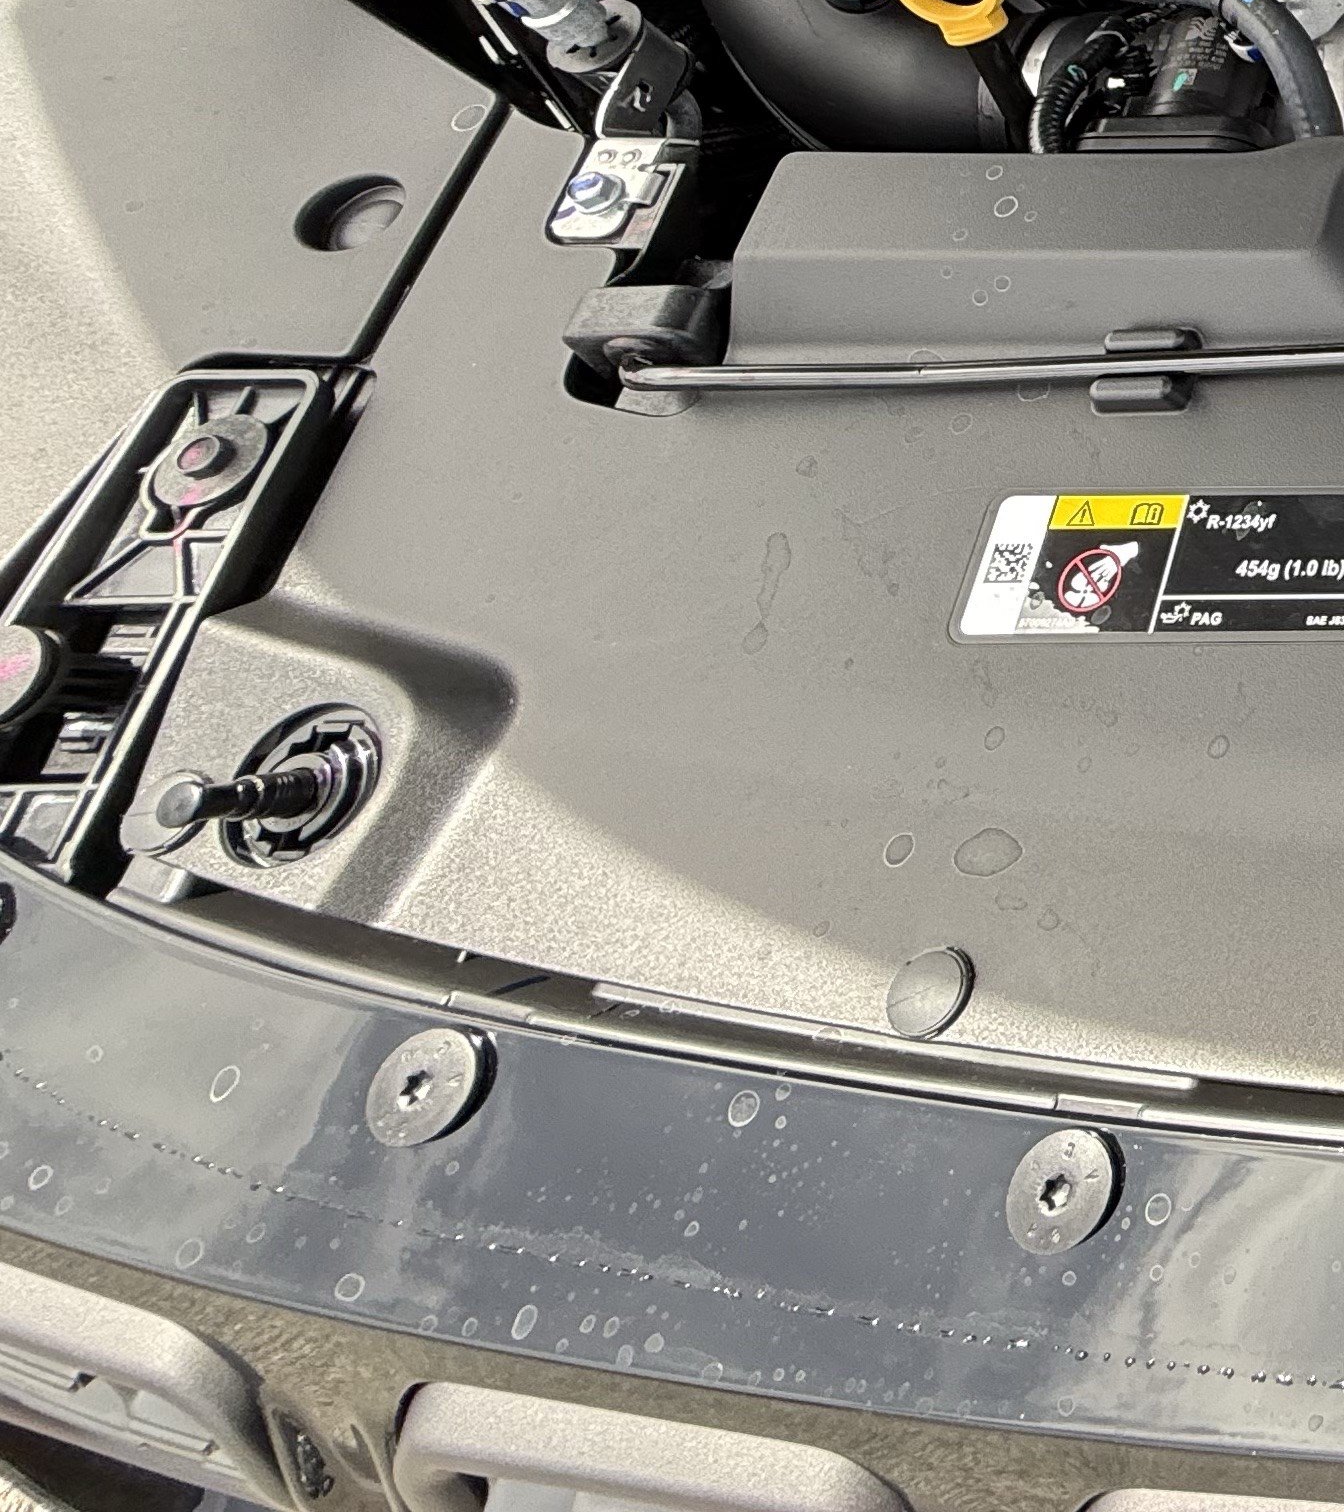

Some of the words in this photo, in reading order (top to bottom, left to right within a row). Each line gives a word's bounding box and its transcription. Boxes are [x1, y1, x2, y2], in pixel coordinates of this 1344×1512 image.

[1206, 512, 1277, 533] R-1234yf
[1234, 559, 1280, 583] 454g
[1283, 558, 1318, 580] (1.0
[1188, 611, 1223, 626] PAG
[1306, 615, 1328, 626] SAE
